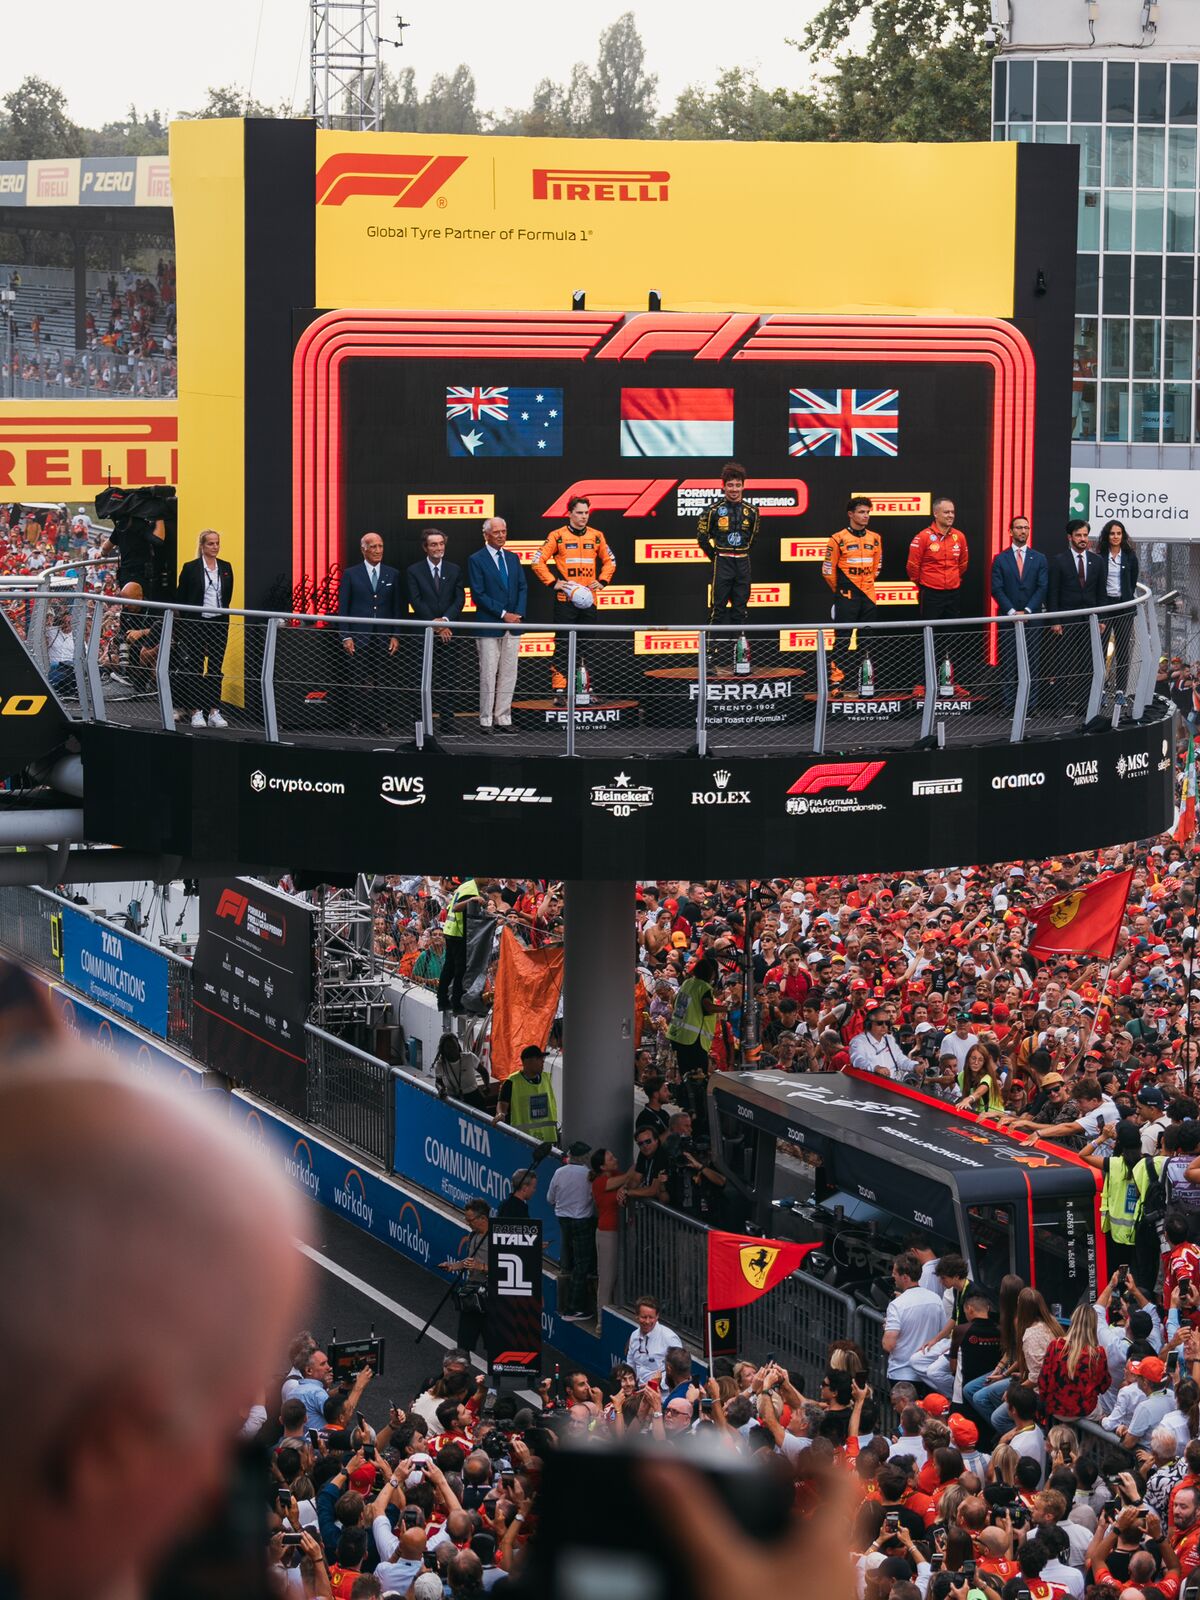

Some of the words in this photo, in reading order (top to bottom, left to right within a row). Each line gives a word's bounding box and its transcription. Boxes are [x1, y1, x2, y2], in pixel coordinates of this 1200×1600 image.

[0, 175, 25, 193] ERO
[37, 168, 69, 197] PIRELLI
[82, 172, 93, 191] P
[94, 172, 134, 191] ZERO
[147, 165, 172, 197] PIRE
[532, 169, 671, 202] PIRELLI
[367, 226, 407, 239] Global
[411, 227, 442, 240] Tyre
[444, 227, 496, 240] Partner
[499, 228, 515, 240] of
[517, 229, 577, 241] Formula
[677, 488, 725, 498] FORMUL
[1095, 489, 1168, 504] Regione
[418, 499, 484, 514] PIRELLI
[752, 498, 796, 507] PREMIO
[1095, 505, 1189, 520] Lombardia
[645, 544, 709, 559] PIRELL
[790, 542, 828, 558] PIRE
[596, 589, 635, 605] ELLI
[645, 635, 700, 650] PIRELL
[688, 681, 792, 701] FERRARI
[755, 703, 775, 711] 1902
[831, 701, 901, 714] FERRARI
[724, 715, 742, 724] Toast
[745, 714, 754, 723] of
[755, 714, 781, 723] Formula
[1066, 759, 1099, 780] QATAR
[1127, 752, 1149, 771] MSC
[268, 776, 345, 795] crypto.com
[381, 774, 425, 794] aws
[912, 777, 964, 796] PIRELLI
[991, 772, 1046, 790] aramco
[1073, 774, 1099, 786] AIRWAYS
[474, 786, 543, 803] DHL
[594, 790, 651, 803] Heineken
[691, 791, 751, 805] ROLEX
[809, 799, 823, 807] FIA
[823, 798, 852, 806] Formula
[809, 805, 833, 814] World
[101, 931, 123, 961] TATA
[81, 948, 146, 1003] COMMUNICATIONS
[737, 1104, 754, 1121] zoom
[458, 1116, 491, 1158] TATA
[787, 1127, 805, 1143] zoom
[284, 1156, 320, 1194] workday
[424, 1136, 513, 1202] COMMUNICATIO
[857, 1184, 876, 1201] zoom
[334, 1186, 373, 1228] workday
[913, 1210, 934, 1228] zoom
[493, 1224, 522, 1234] RACE
[523, 1225, 538, 1235] 16
[389, 1218, 430, 1263] workday
[493, 1233, 538, 1246] ITALY
[498, 1253, 533, 1296] 1
[1088, 1263, 1096, 1288] KEYNES
